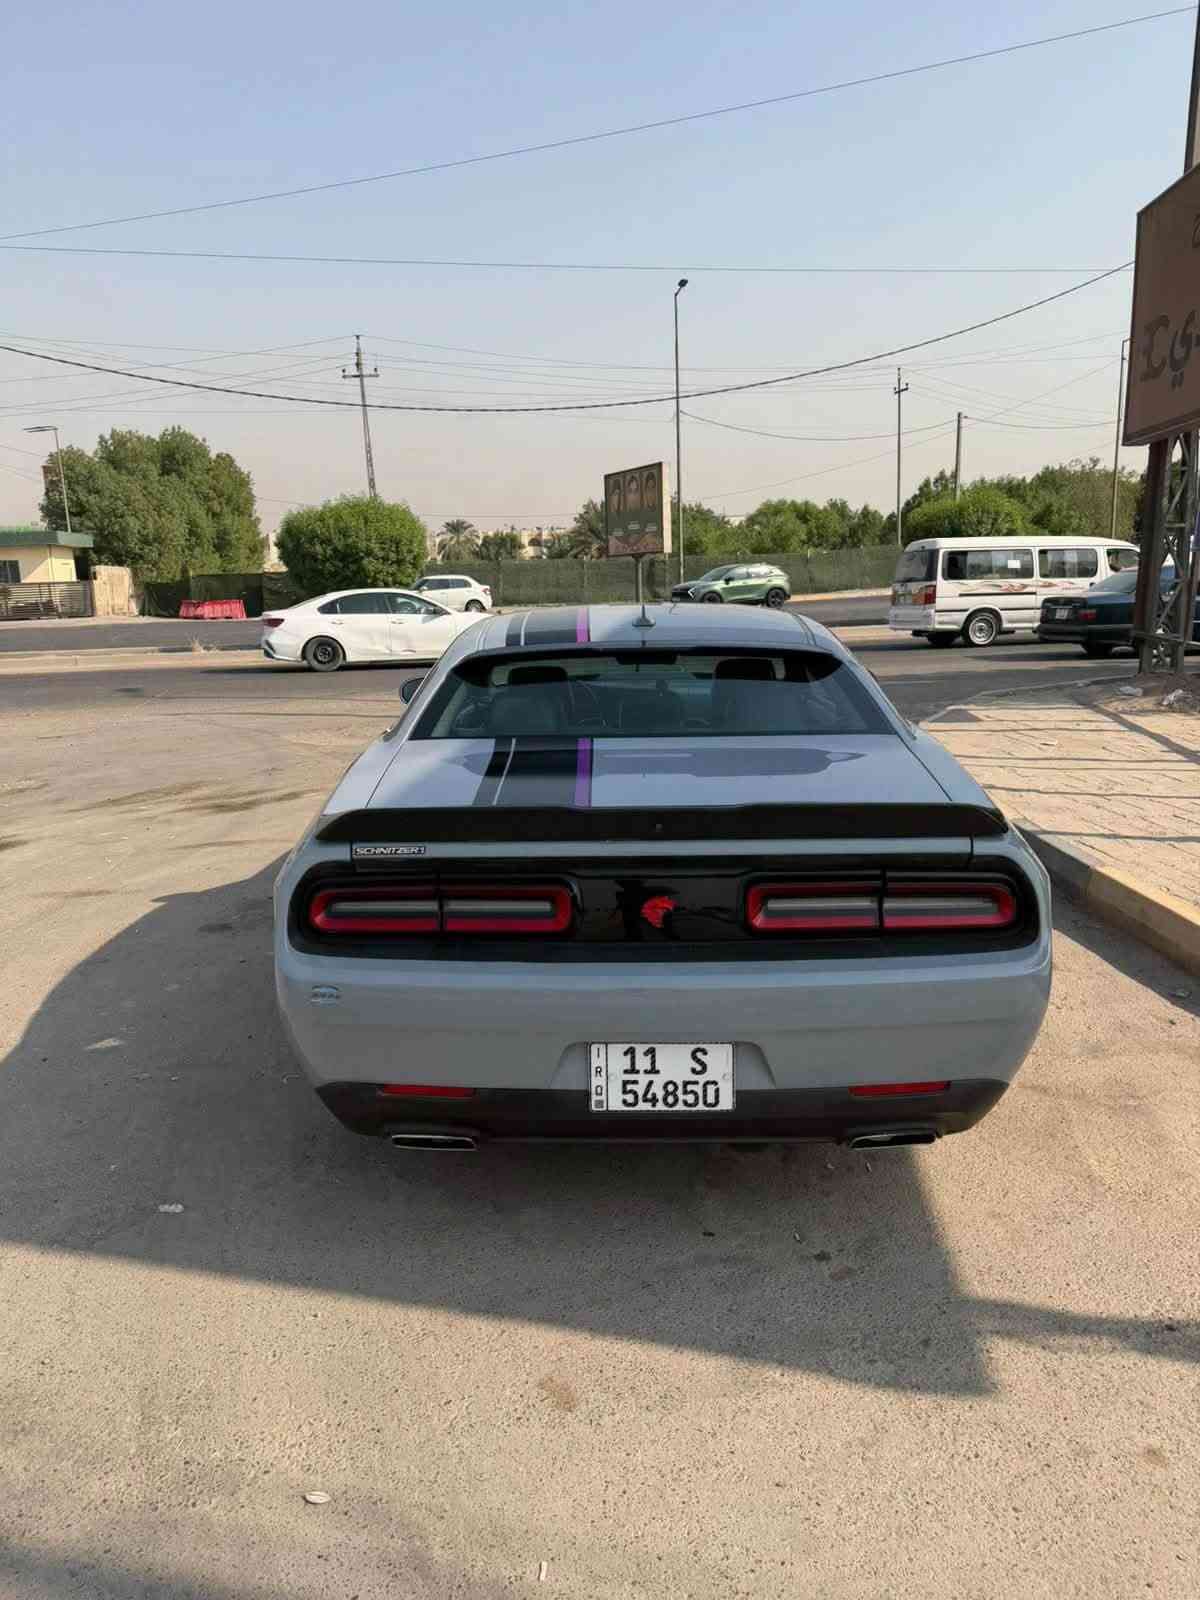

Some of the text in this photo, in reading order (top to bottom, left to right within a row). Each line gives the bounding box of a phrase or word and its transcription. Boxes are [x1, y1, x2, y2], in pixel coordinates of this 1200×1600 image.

[595, 1047, 603, 1096] IRQ
[623, 1046, 708, 1075] 11 S
[622, 1079, 720, 1108] 54850
